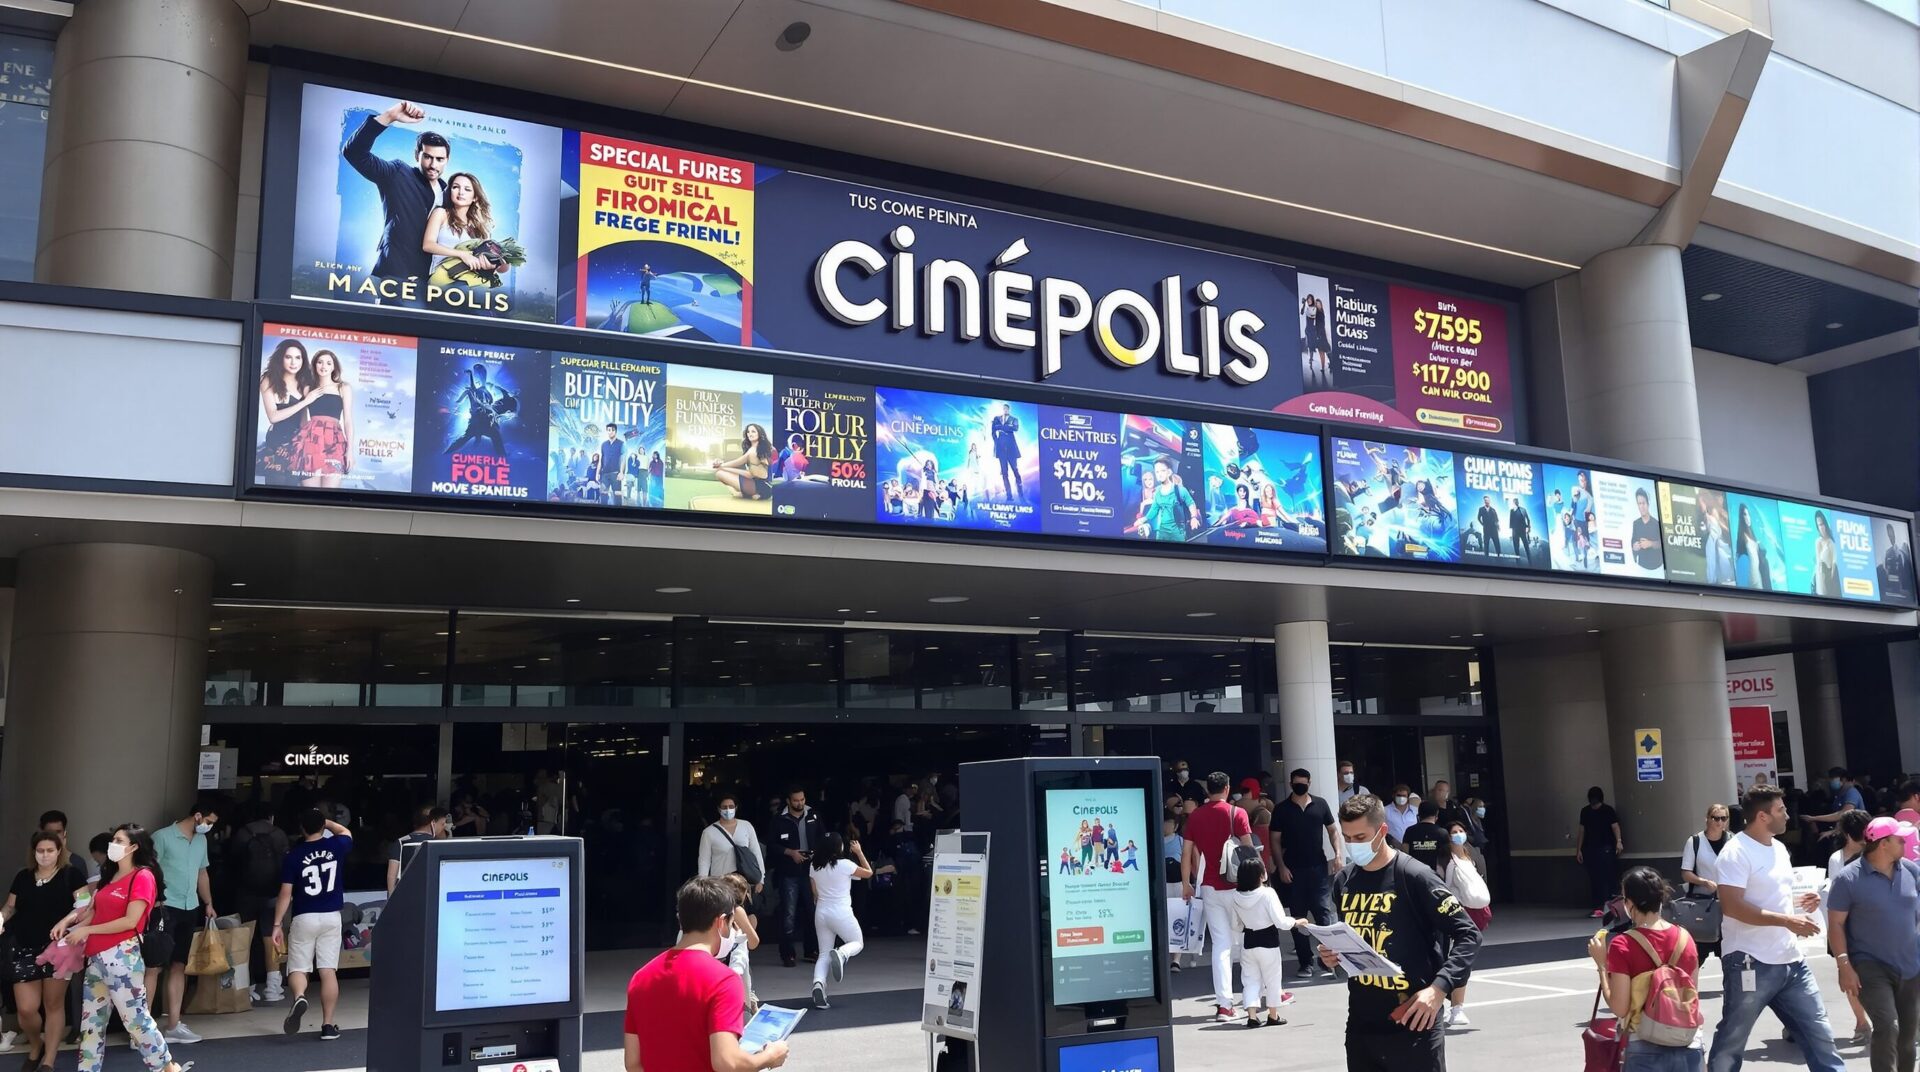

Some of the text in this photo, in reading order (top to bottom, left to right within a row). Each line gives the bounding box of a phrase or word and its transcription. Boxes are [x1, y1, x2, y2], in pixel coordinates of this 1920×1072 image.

[590, 143, 742, 184] SPECIAL FURES
[624, 174, 714, 200] GUIT SELL
[596, 187, 738, 226] FIROMICAL
[849, 193, 978, 230] TUS COME PEINTA
[595, 211, 660, 234] FREGE
[426, 285, 509, 312] POLIS
[565, 372, 656, 403] BUENDAY
[785, 407, 867, 437] FOLUR
[452, 463, 509, 485] FOLE
[831, 462, 866, 478] 50%
[432, 481, 468, 494] MOVE
[285, 744, 349, 766] CINÉPOLIS
[302, 860, 337, 896] 37
[1341, 893, 1397, 913] LIVES
